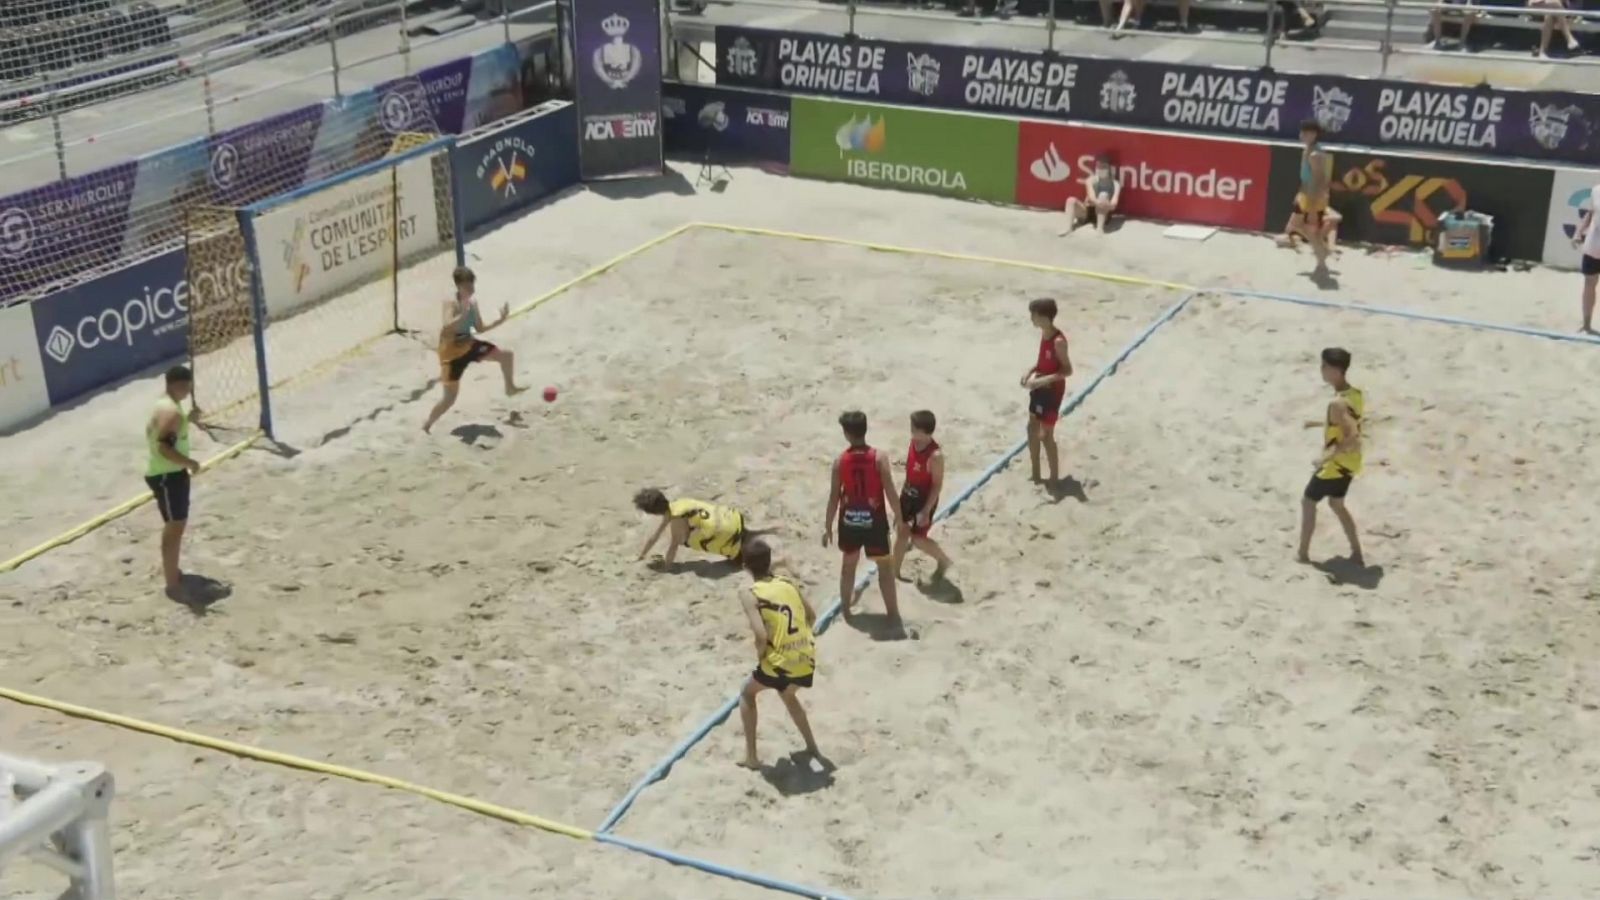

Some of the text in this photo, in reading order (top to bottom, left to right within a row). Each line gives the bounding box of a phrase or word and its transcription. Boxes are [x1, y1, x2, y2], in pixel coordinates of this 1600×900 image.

[778, 38, 885, 71] PLAYAS DE
[780, 64, 881, 95] ORIHUELA
[962, 55, 1078, 87] PLAYAS DE
[964, 82, 1071, 113] ORIHUELA
[1161, 72, 1289, 105] PLAYAS DE
[1163, 101, 1281, 131] ORIHUELA
[1377, 89, 1505, 122] PLAYAS DE
[1380, 116, 1496, 148] ORIHUELA
[847, 158, 967, 190] IBERDROLA
[1076, 154, 1252, 202] Sntander
[321, 246, 343, 272] DE
[780, 604, 799, 635] 2
